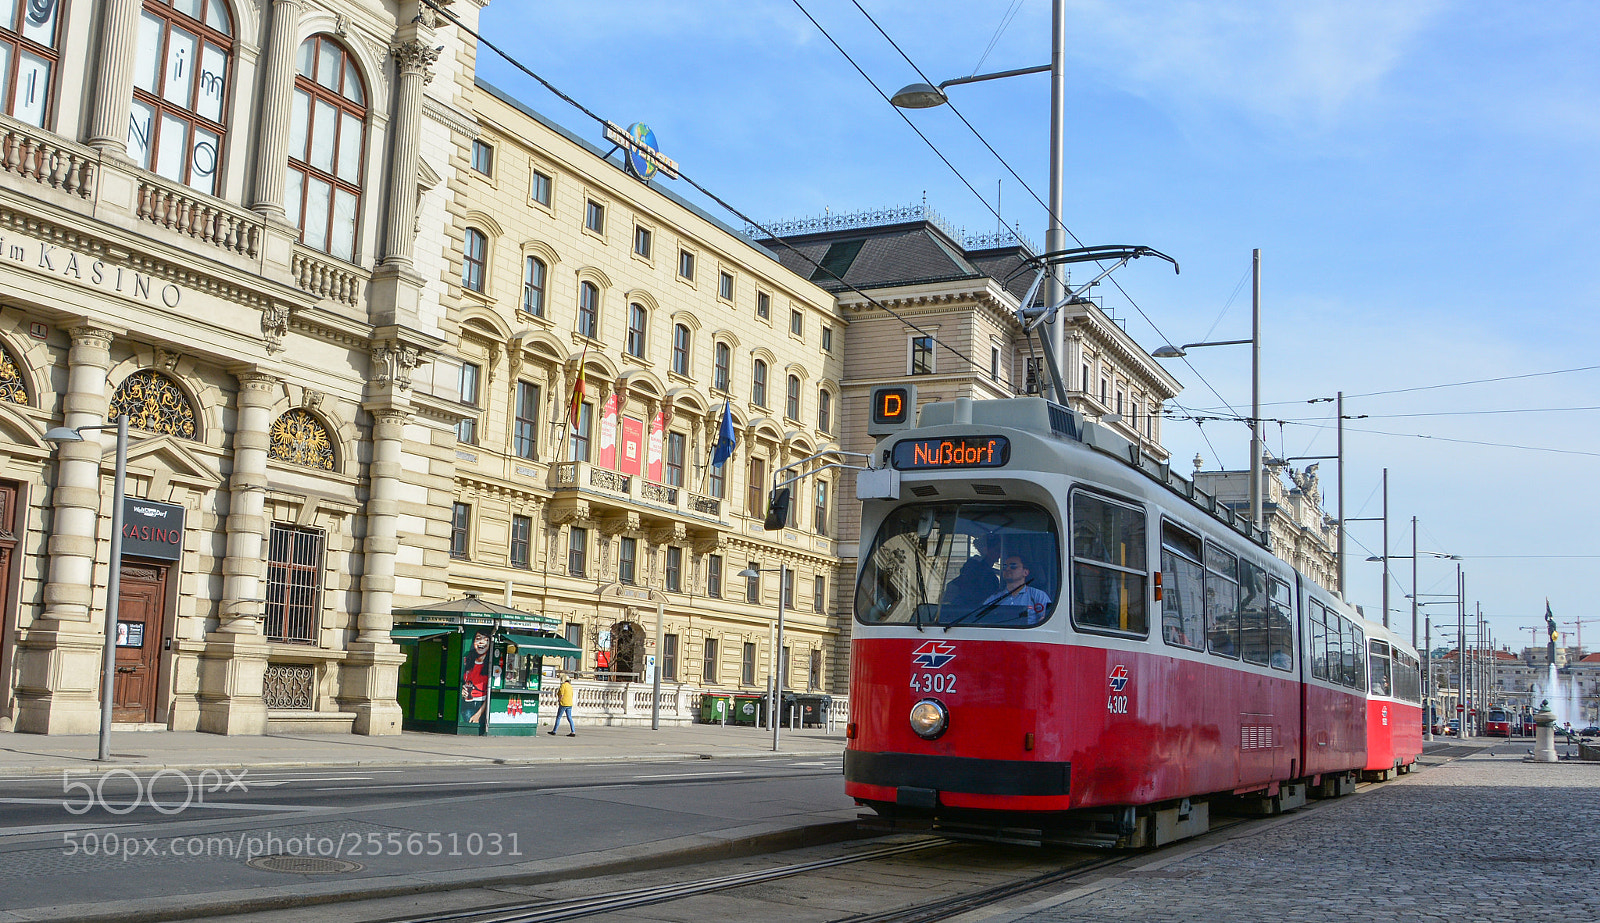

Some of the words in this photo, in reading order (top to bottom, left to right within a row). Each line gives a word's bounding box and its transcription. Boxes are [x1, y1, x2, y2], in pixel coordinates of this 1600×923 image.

[37, 242, 181, 308] KASINO
[883, 394, 902, 416] D
[914, 440, 996, 465] Nußdorf
[909, 674, 957, 694] 4302
[1107, 695, 1128, 714] 4302
